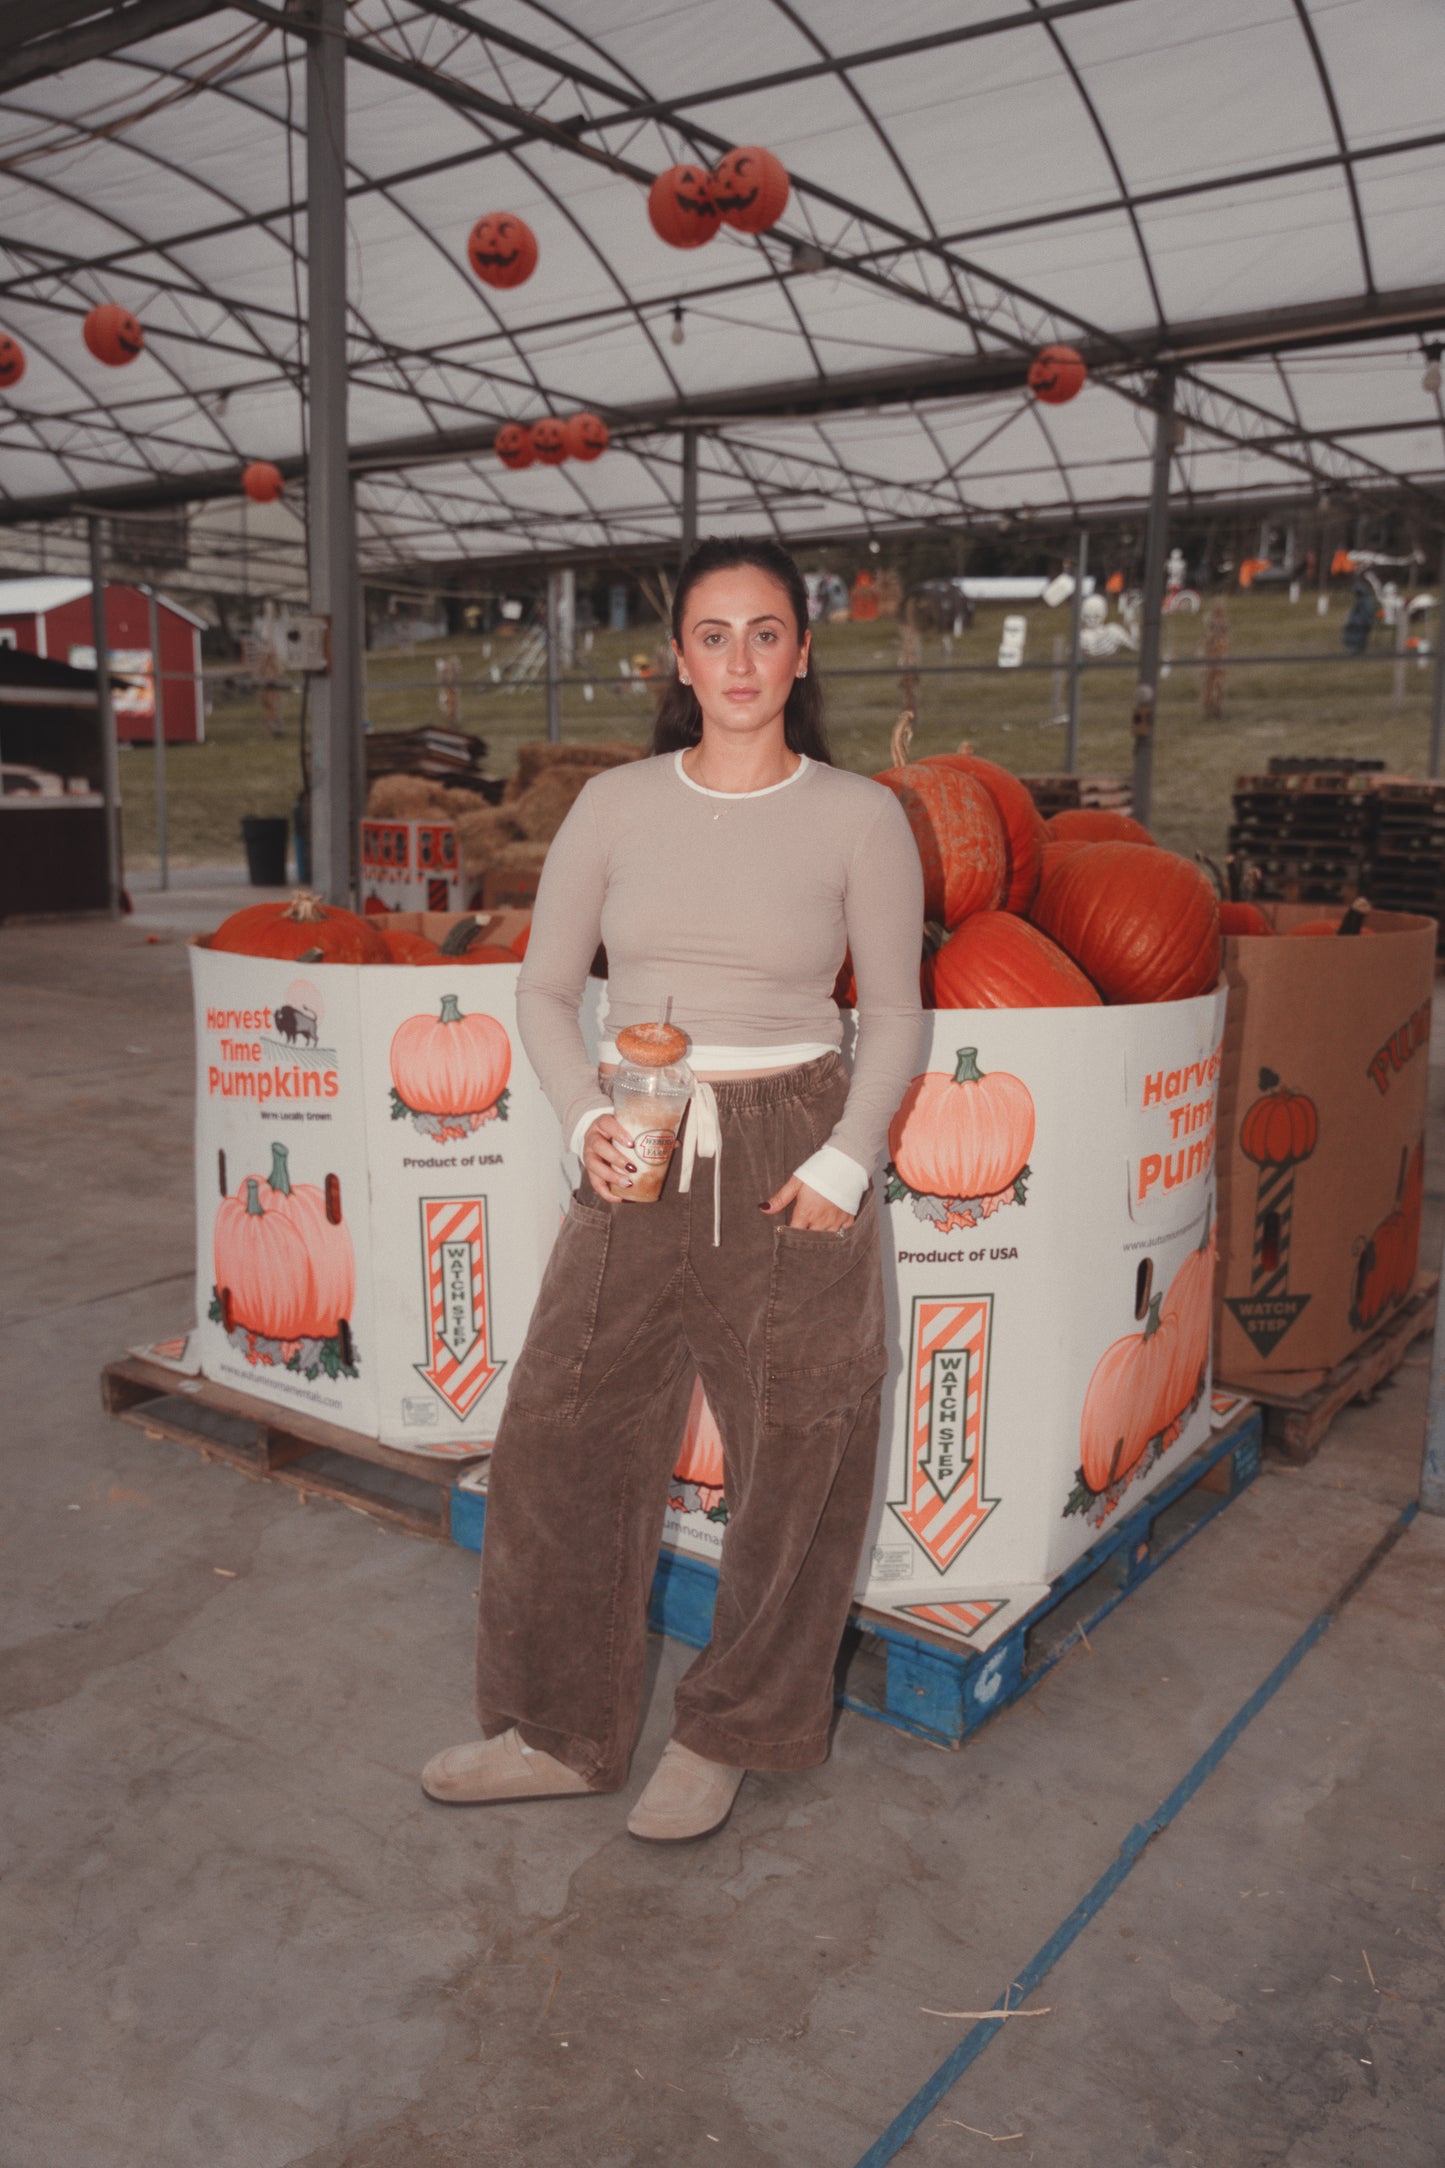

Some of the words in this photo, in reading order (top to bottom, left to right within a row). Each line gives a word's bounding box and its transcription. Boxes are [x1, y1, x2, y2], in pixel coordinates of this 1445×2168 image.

[206, 1006, 271, 1030] Harvest
[221, 1039, 262, 1062] Time
[209, 1065, 339, 1103] Pumpkins
[403, 1157, 457, 1168] Product
[461, 1156, 475, 1167] of
[478, 1154, 504, 1165] USA
[898, 1250, 965, 1263] Product
[969, 1249, 986, 1262] of
[989, 1247, 1018, 1260] USA
[448, 1249, 466, 1301] WATCH
[1239, 1302, 1297, 1315] WATCH
[452, 1306, 466, 1346] STEP
[1247, 1319, 1288, 1332] STEP
[939, 1358, 961, 1422] WATCH
[938, 1428, 955, 1480] STEP
